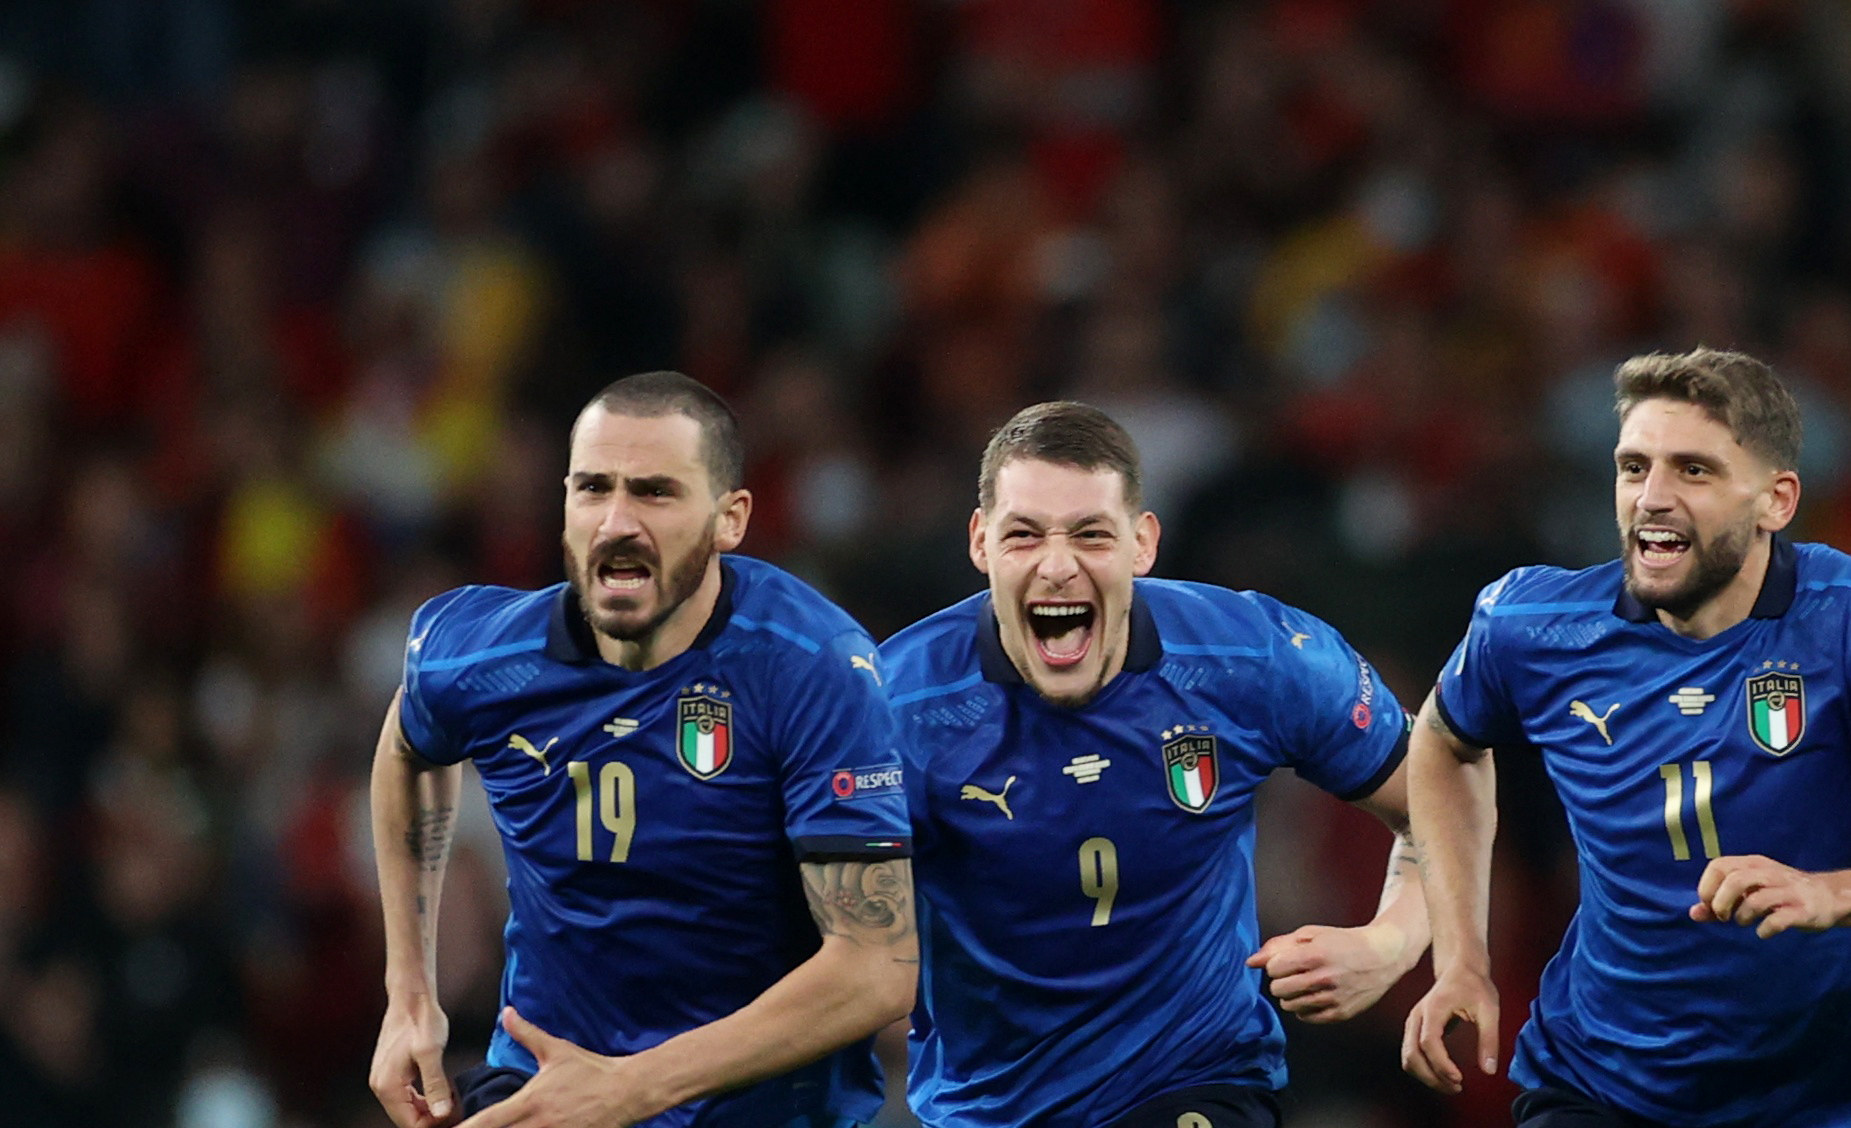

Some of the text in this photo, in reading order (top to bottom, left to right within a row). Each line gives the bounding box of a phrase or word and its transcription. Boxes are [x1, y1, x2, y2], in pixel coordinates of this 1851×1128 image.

[1752, 679, 1798, 694] ITALIA
[683, 703, 726, 718] ITALIA
[1167, 740, 1211, 759] ITALIA
[855, 770, 903, 790] RESPECT
[567, 761, 636, 864] 19
[1659, 760, 1722, 861] 11
[1078, 836, 1119, 926] 9
